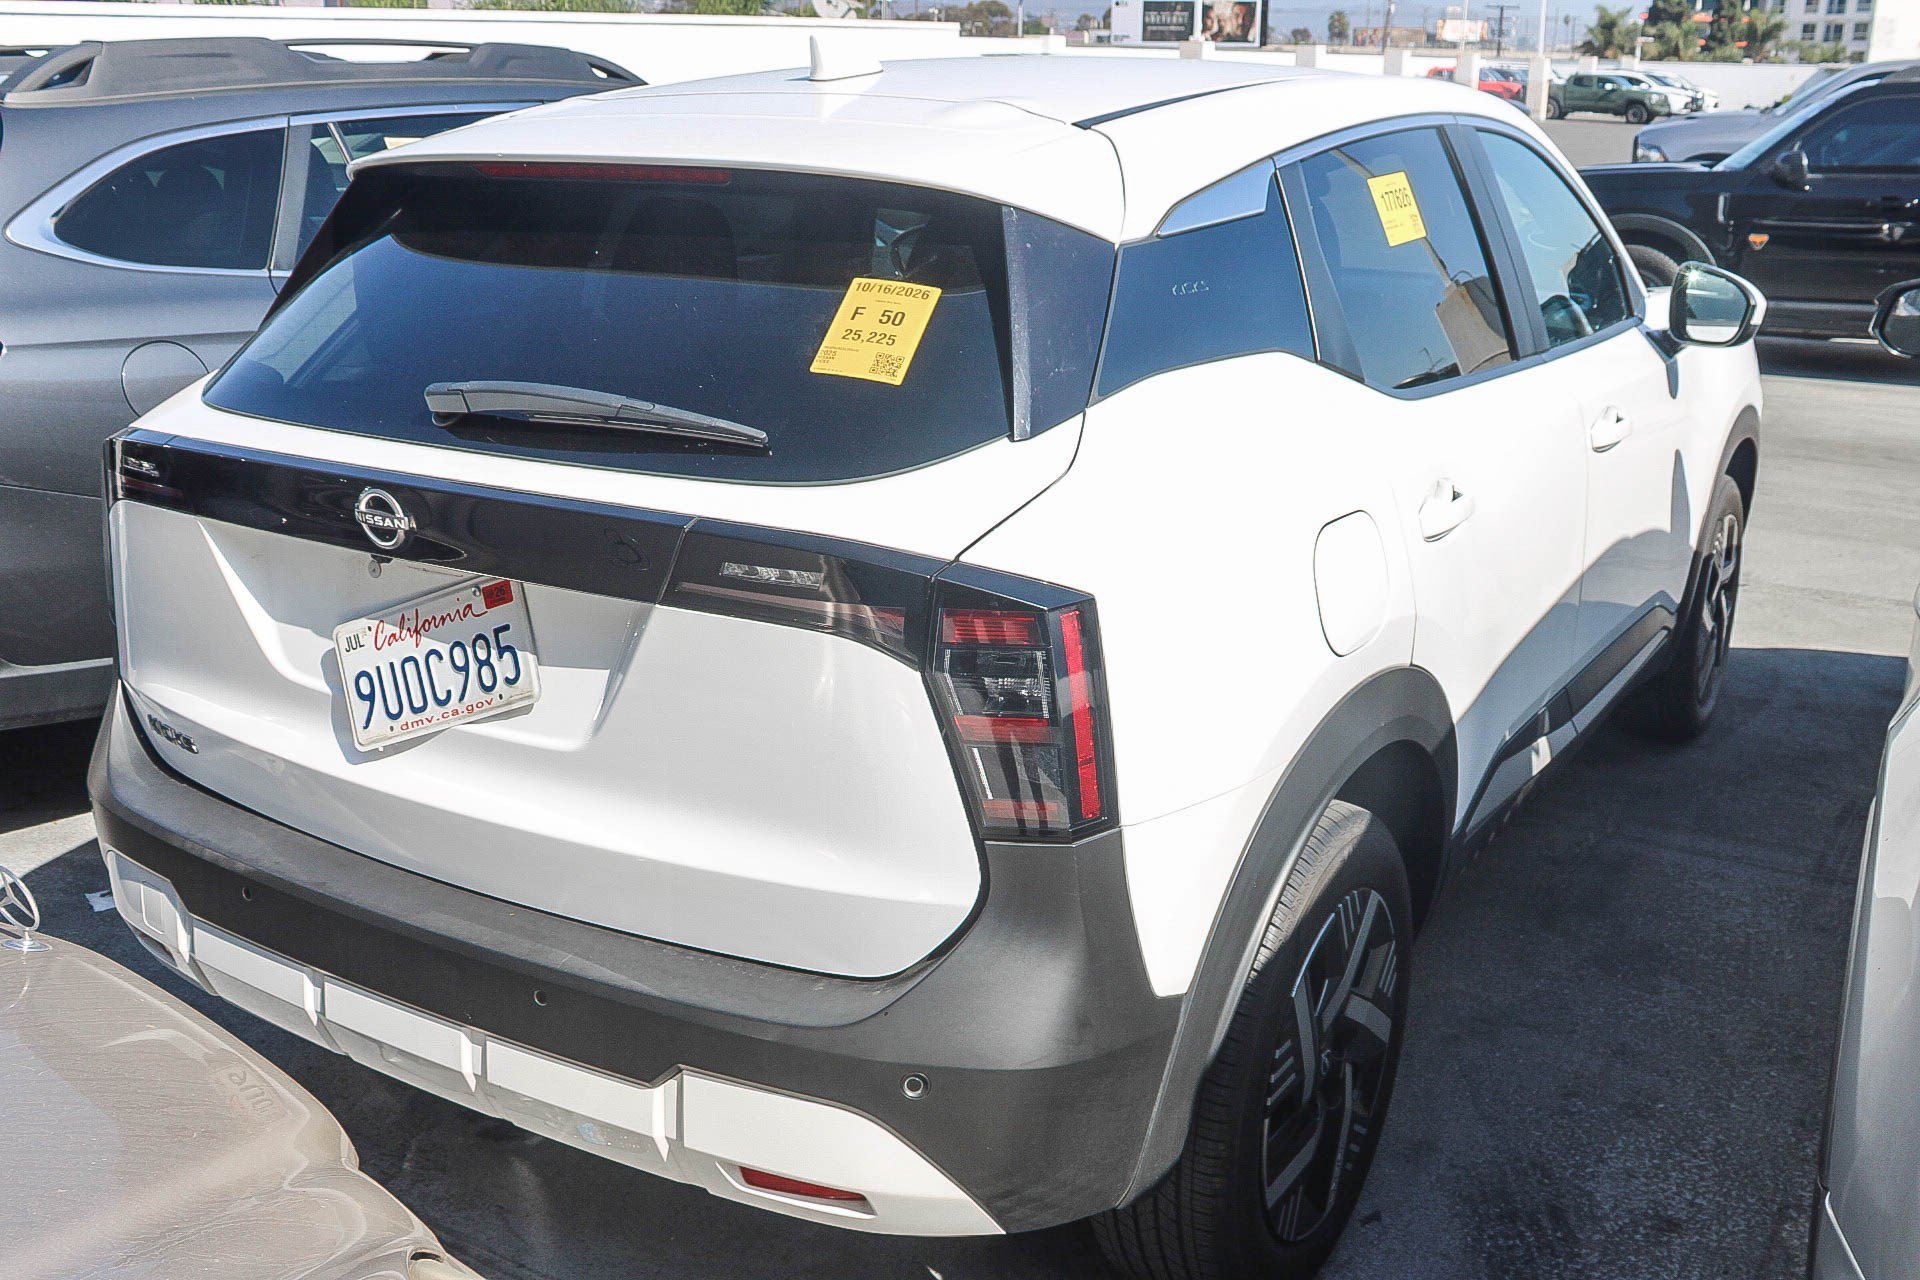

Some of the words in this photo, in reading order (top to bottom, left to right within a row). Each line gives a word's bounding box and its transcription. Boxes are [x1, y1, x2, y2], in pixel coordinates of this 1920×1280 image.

[1381, 187, 1412, 211] 177626
[855, 282, 931, 300] 10/16/2026
[850, 306, 867, 321] F
[878, 309, 906, 327] 50
[841, 328, 897, 346] 25,225
[355, 510, 408, 530] NISSAN
[374, 598, 488, 651] California
[345, 633, 365, 652] JUL
[354, 623, 521, 730] 9UOC985
[400, 697, 494, 731] dmv.ca.gov
